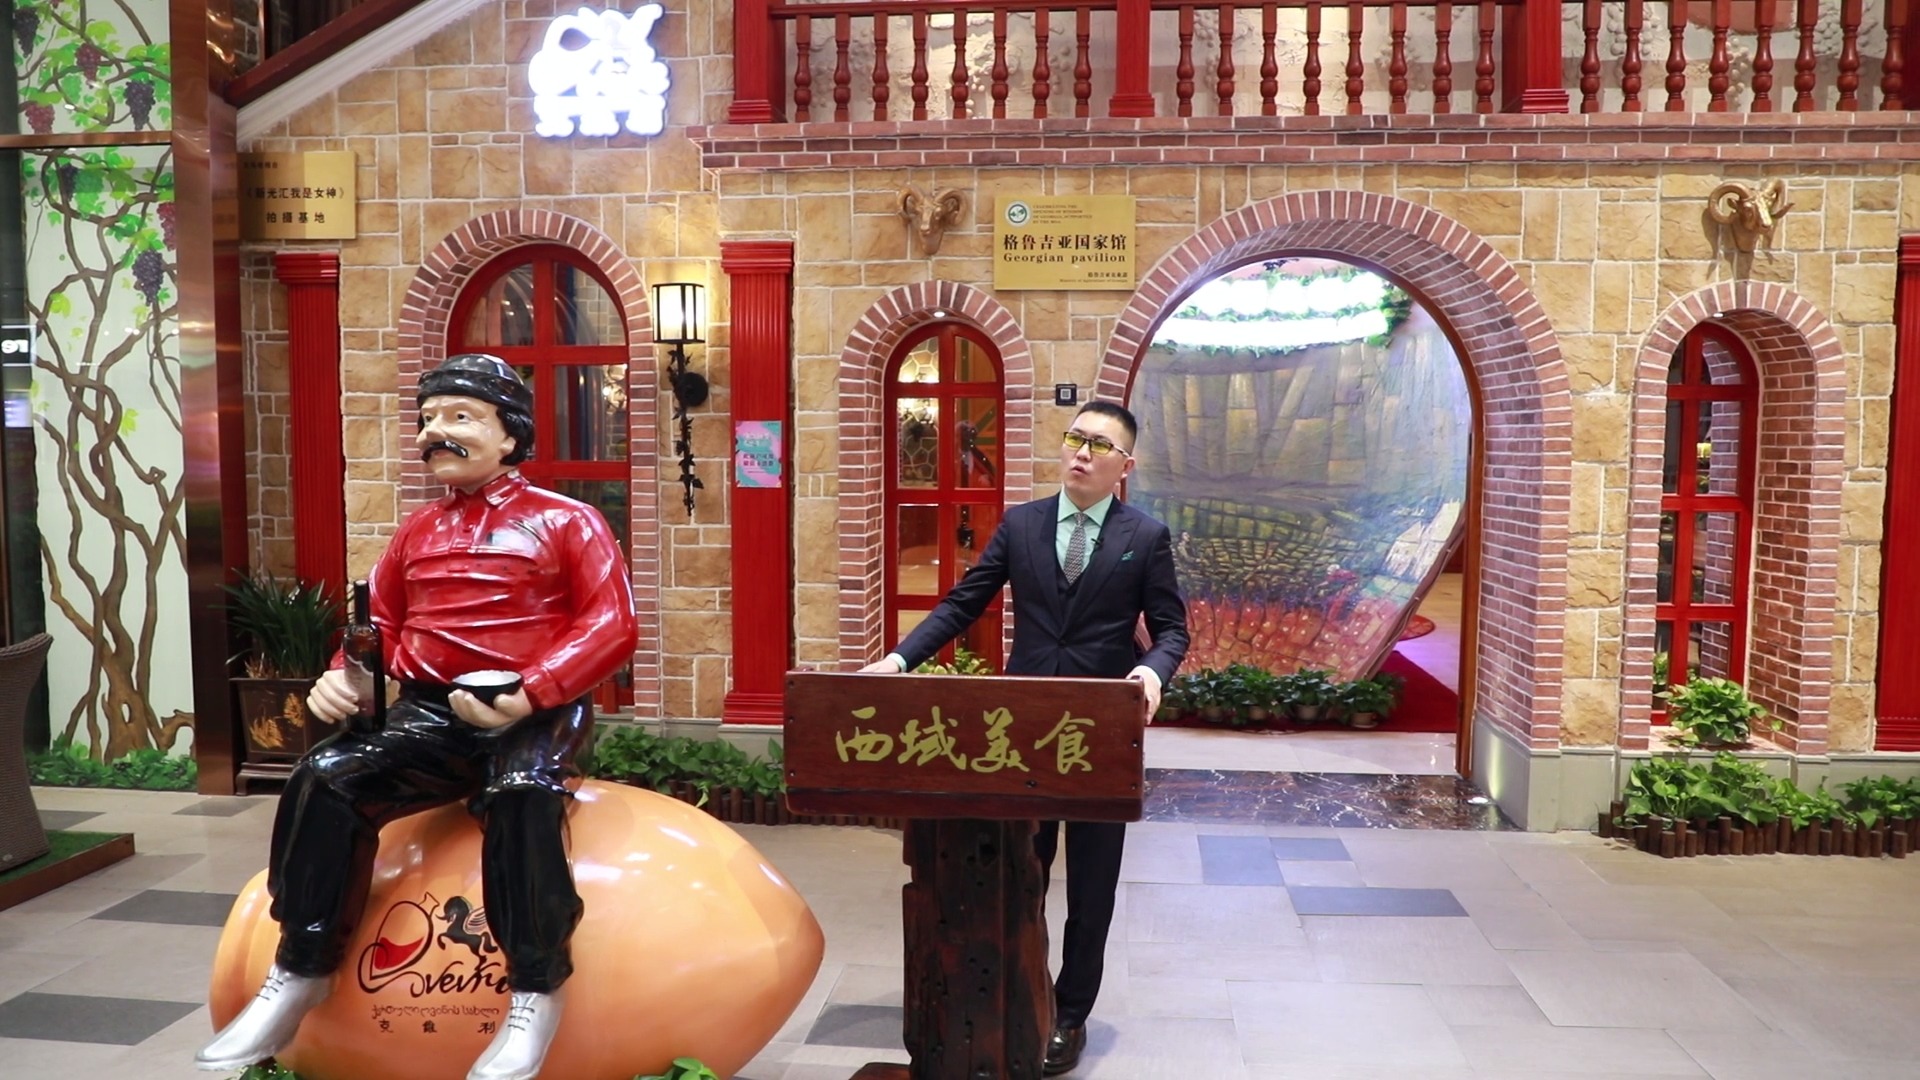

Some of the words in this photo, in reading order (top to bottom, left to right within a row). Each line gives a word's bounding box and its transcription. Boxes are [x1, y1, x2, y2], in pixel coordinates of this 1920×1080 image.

[266, 212, 325, 223] 拍摄基地
[1003, 234, 1127, 250] 格鲁吉亚国家馆
[1003, 252, 1064, 263] Georgian
[1071, 252, 1126, 263] pavilion
[835, 705, 1096, 775] 西域美食
